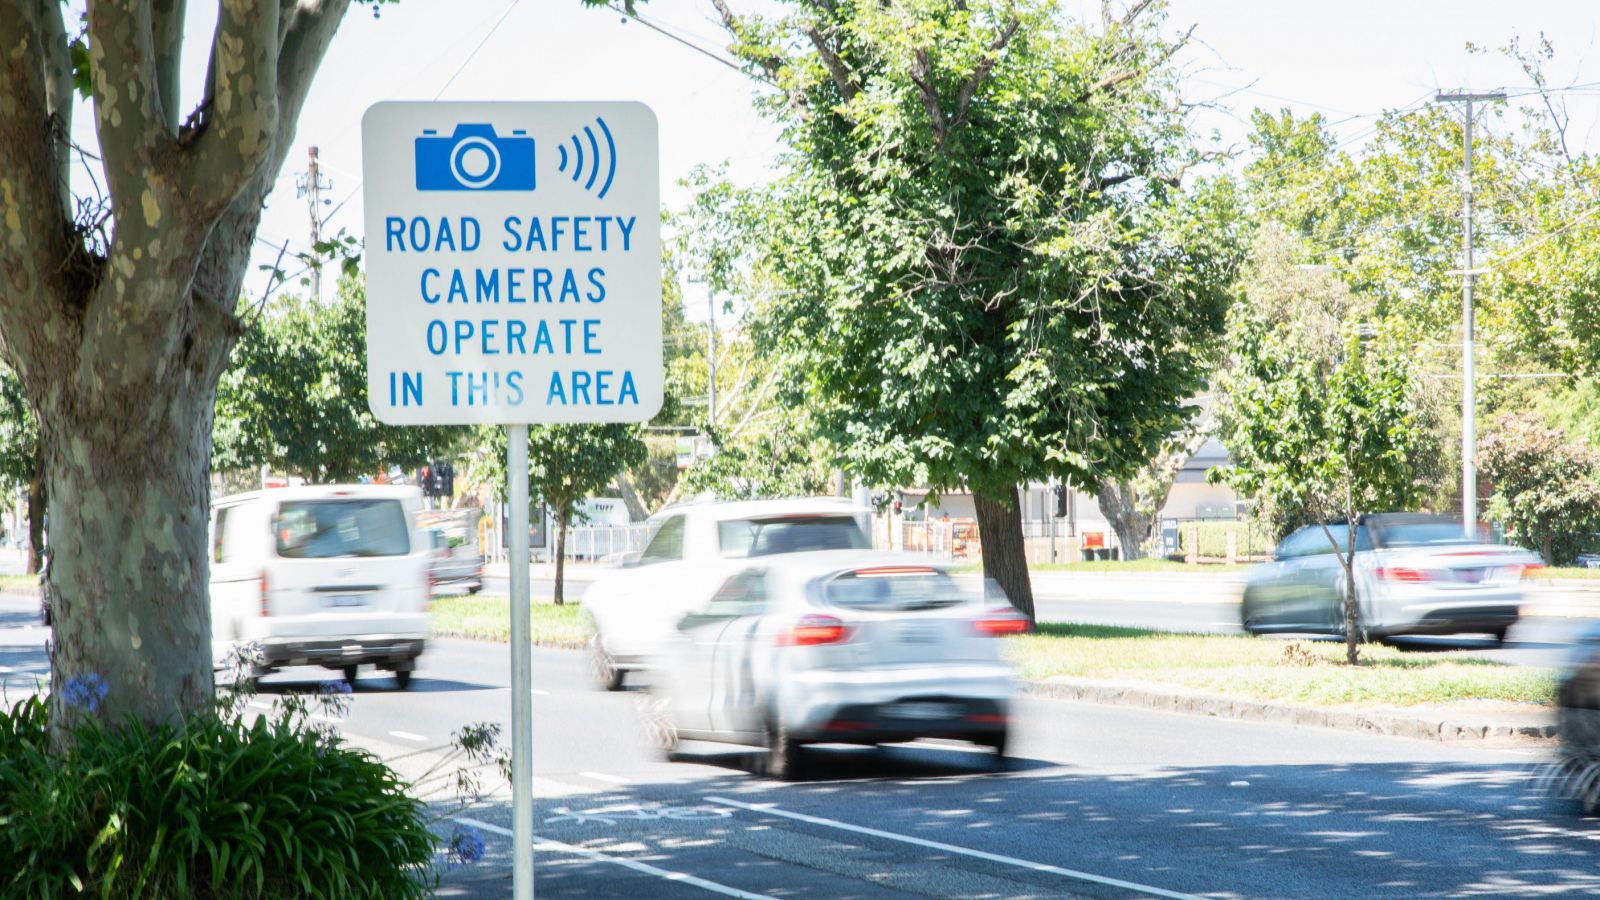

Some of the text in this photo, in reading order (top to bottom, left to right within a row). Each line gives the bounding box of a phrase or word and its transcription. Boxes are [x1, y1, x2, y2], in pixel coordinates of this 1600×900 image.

[385, 216, 636, 251] ROAD SAFETY
[420, 267, 606, 304] CAMERAS
[426, 319, 602, 355] OPERATE
[389, 371, 423, 407] IN
[546, 370, 639, 406] AREA
